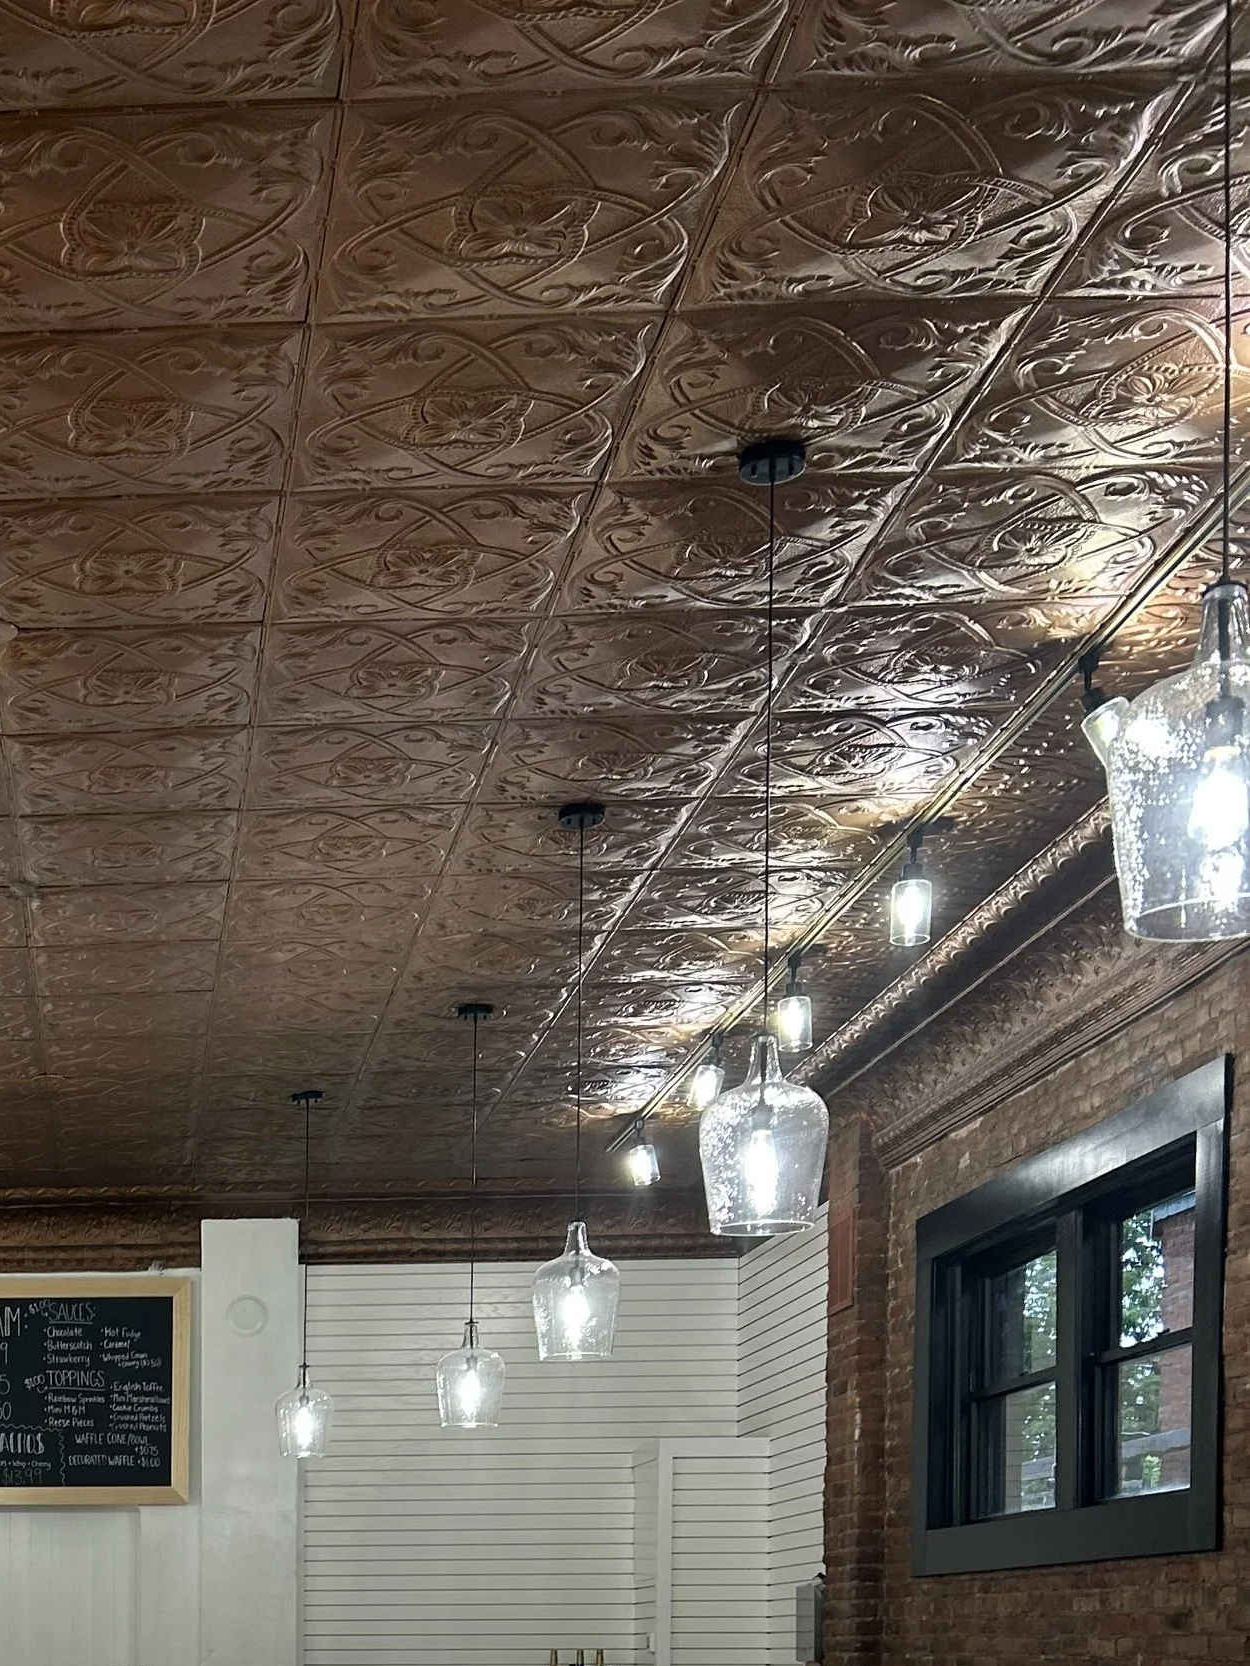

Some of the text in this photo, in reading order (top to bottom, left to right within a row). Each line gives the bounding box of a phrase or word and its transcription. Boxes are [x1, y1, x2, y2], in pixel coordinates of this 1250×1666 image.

[46, 1326, 83, 1338] Chocolate
[104, 1326, 119, 1337] Hot
[46, 1339, 92, 1351] Butterscotch
[103, 1339, 131, 1349] Caramel
[46, 1353, 91, 1367] Strawberry
[46, 1369, 106, 1388] TOPPINGS
[113, 1381, 164, 1394] English Toffee
[48, 1392, 106, 1406] Rainbow Sprinkles
[48, 1416, 95, 1427] Reese Pieces
[75, 1432, 105, 1445] WAFFLE
[108, 1454, 135, 1467] WAFFLE
[2, 1467, 43, 1486] $13.99
